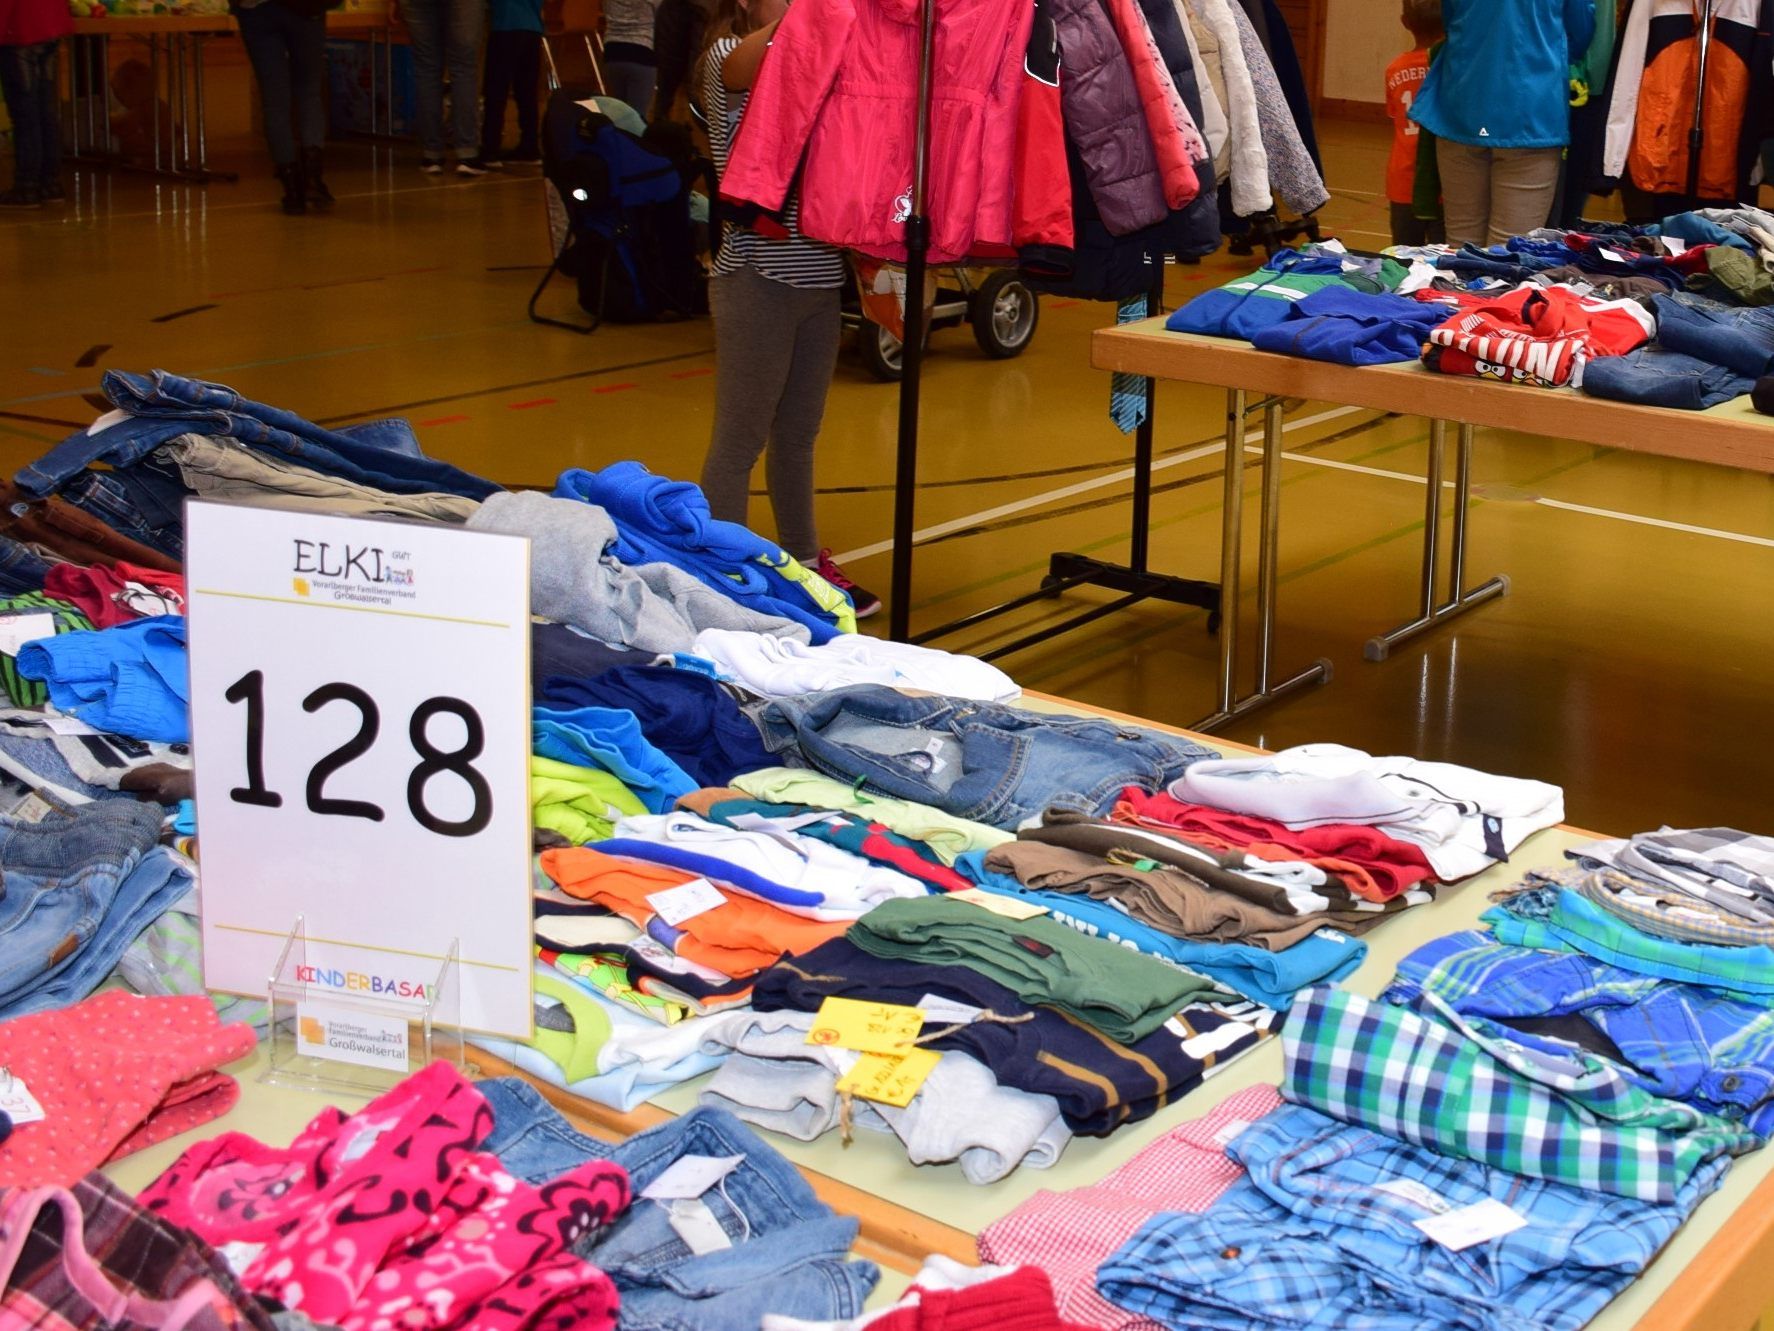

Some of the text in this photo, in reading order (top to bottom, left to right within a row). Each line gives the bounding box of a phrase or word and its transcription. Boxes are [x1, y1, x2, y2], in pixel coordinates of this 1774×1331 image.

[1388, 66, 1431, 90] NEDER
[293, 539, 384, 583] ELKI
[312, 579, 416, 599] Vorarlberger Familienverband
[225, 669, 494, 837] 128
[329, 1037, 406, 1060] Großwalsertal
